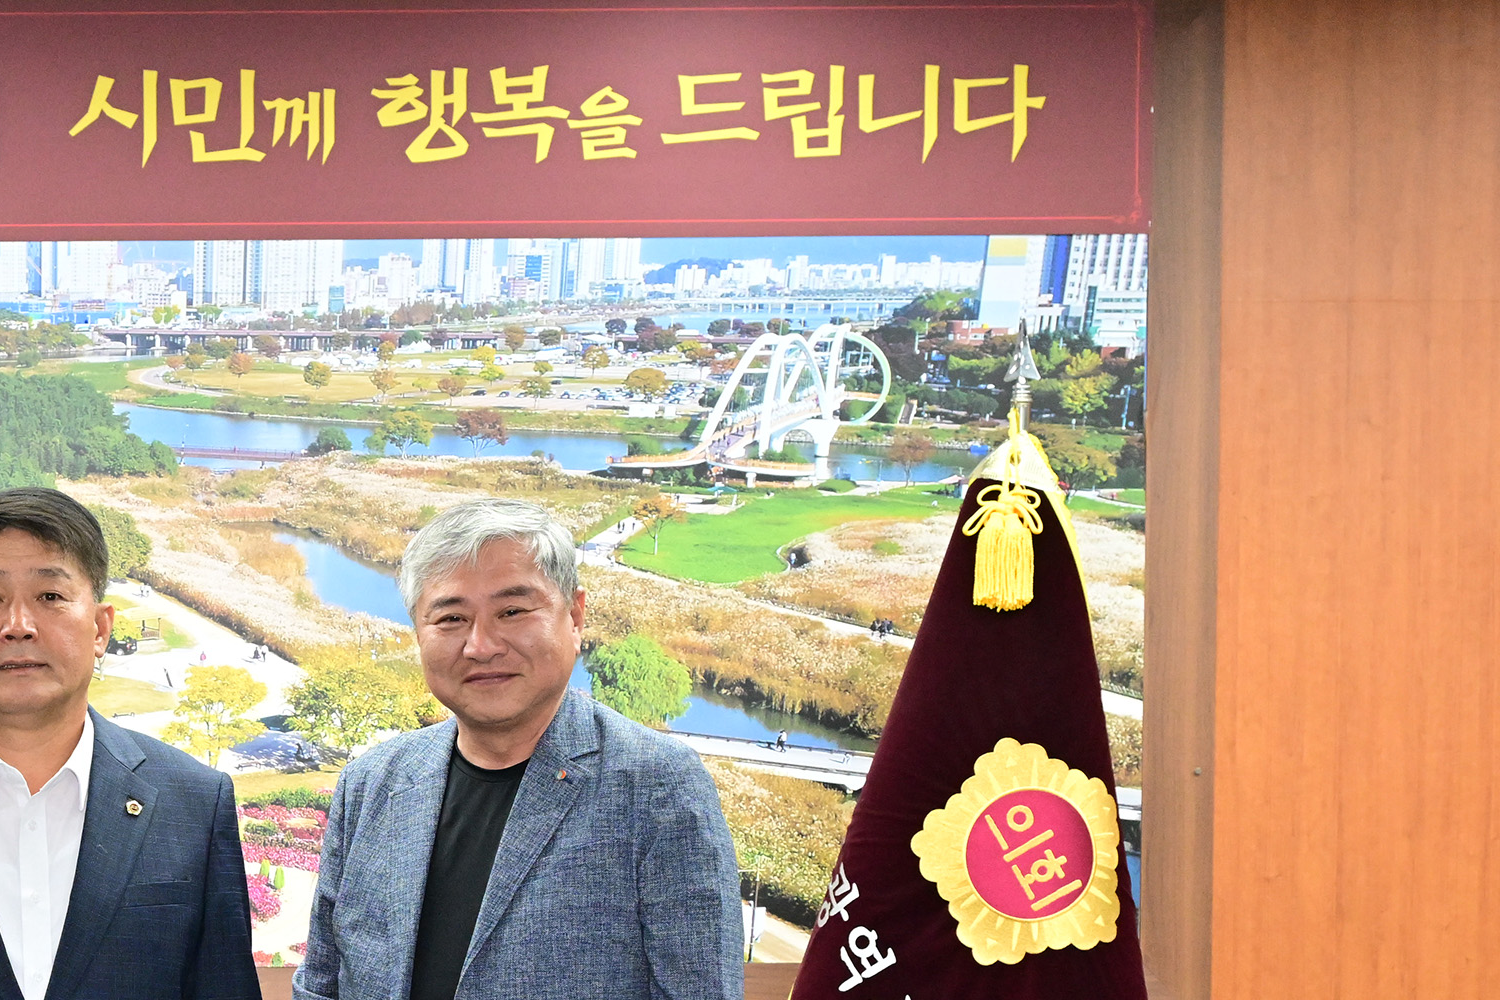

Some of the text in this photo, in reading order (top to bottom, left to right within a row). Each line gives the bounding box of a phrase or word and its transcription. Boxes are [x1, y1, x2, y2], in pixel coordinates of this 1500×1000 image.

[68, 68, 336, 169] 시민께
[370, 64, 644, 164] 행복을
[660, 63, 1047, 164] 드립니다
[984, 804, 1083, 912] 의회
